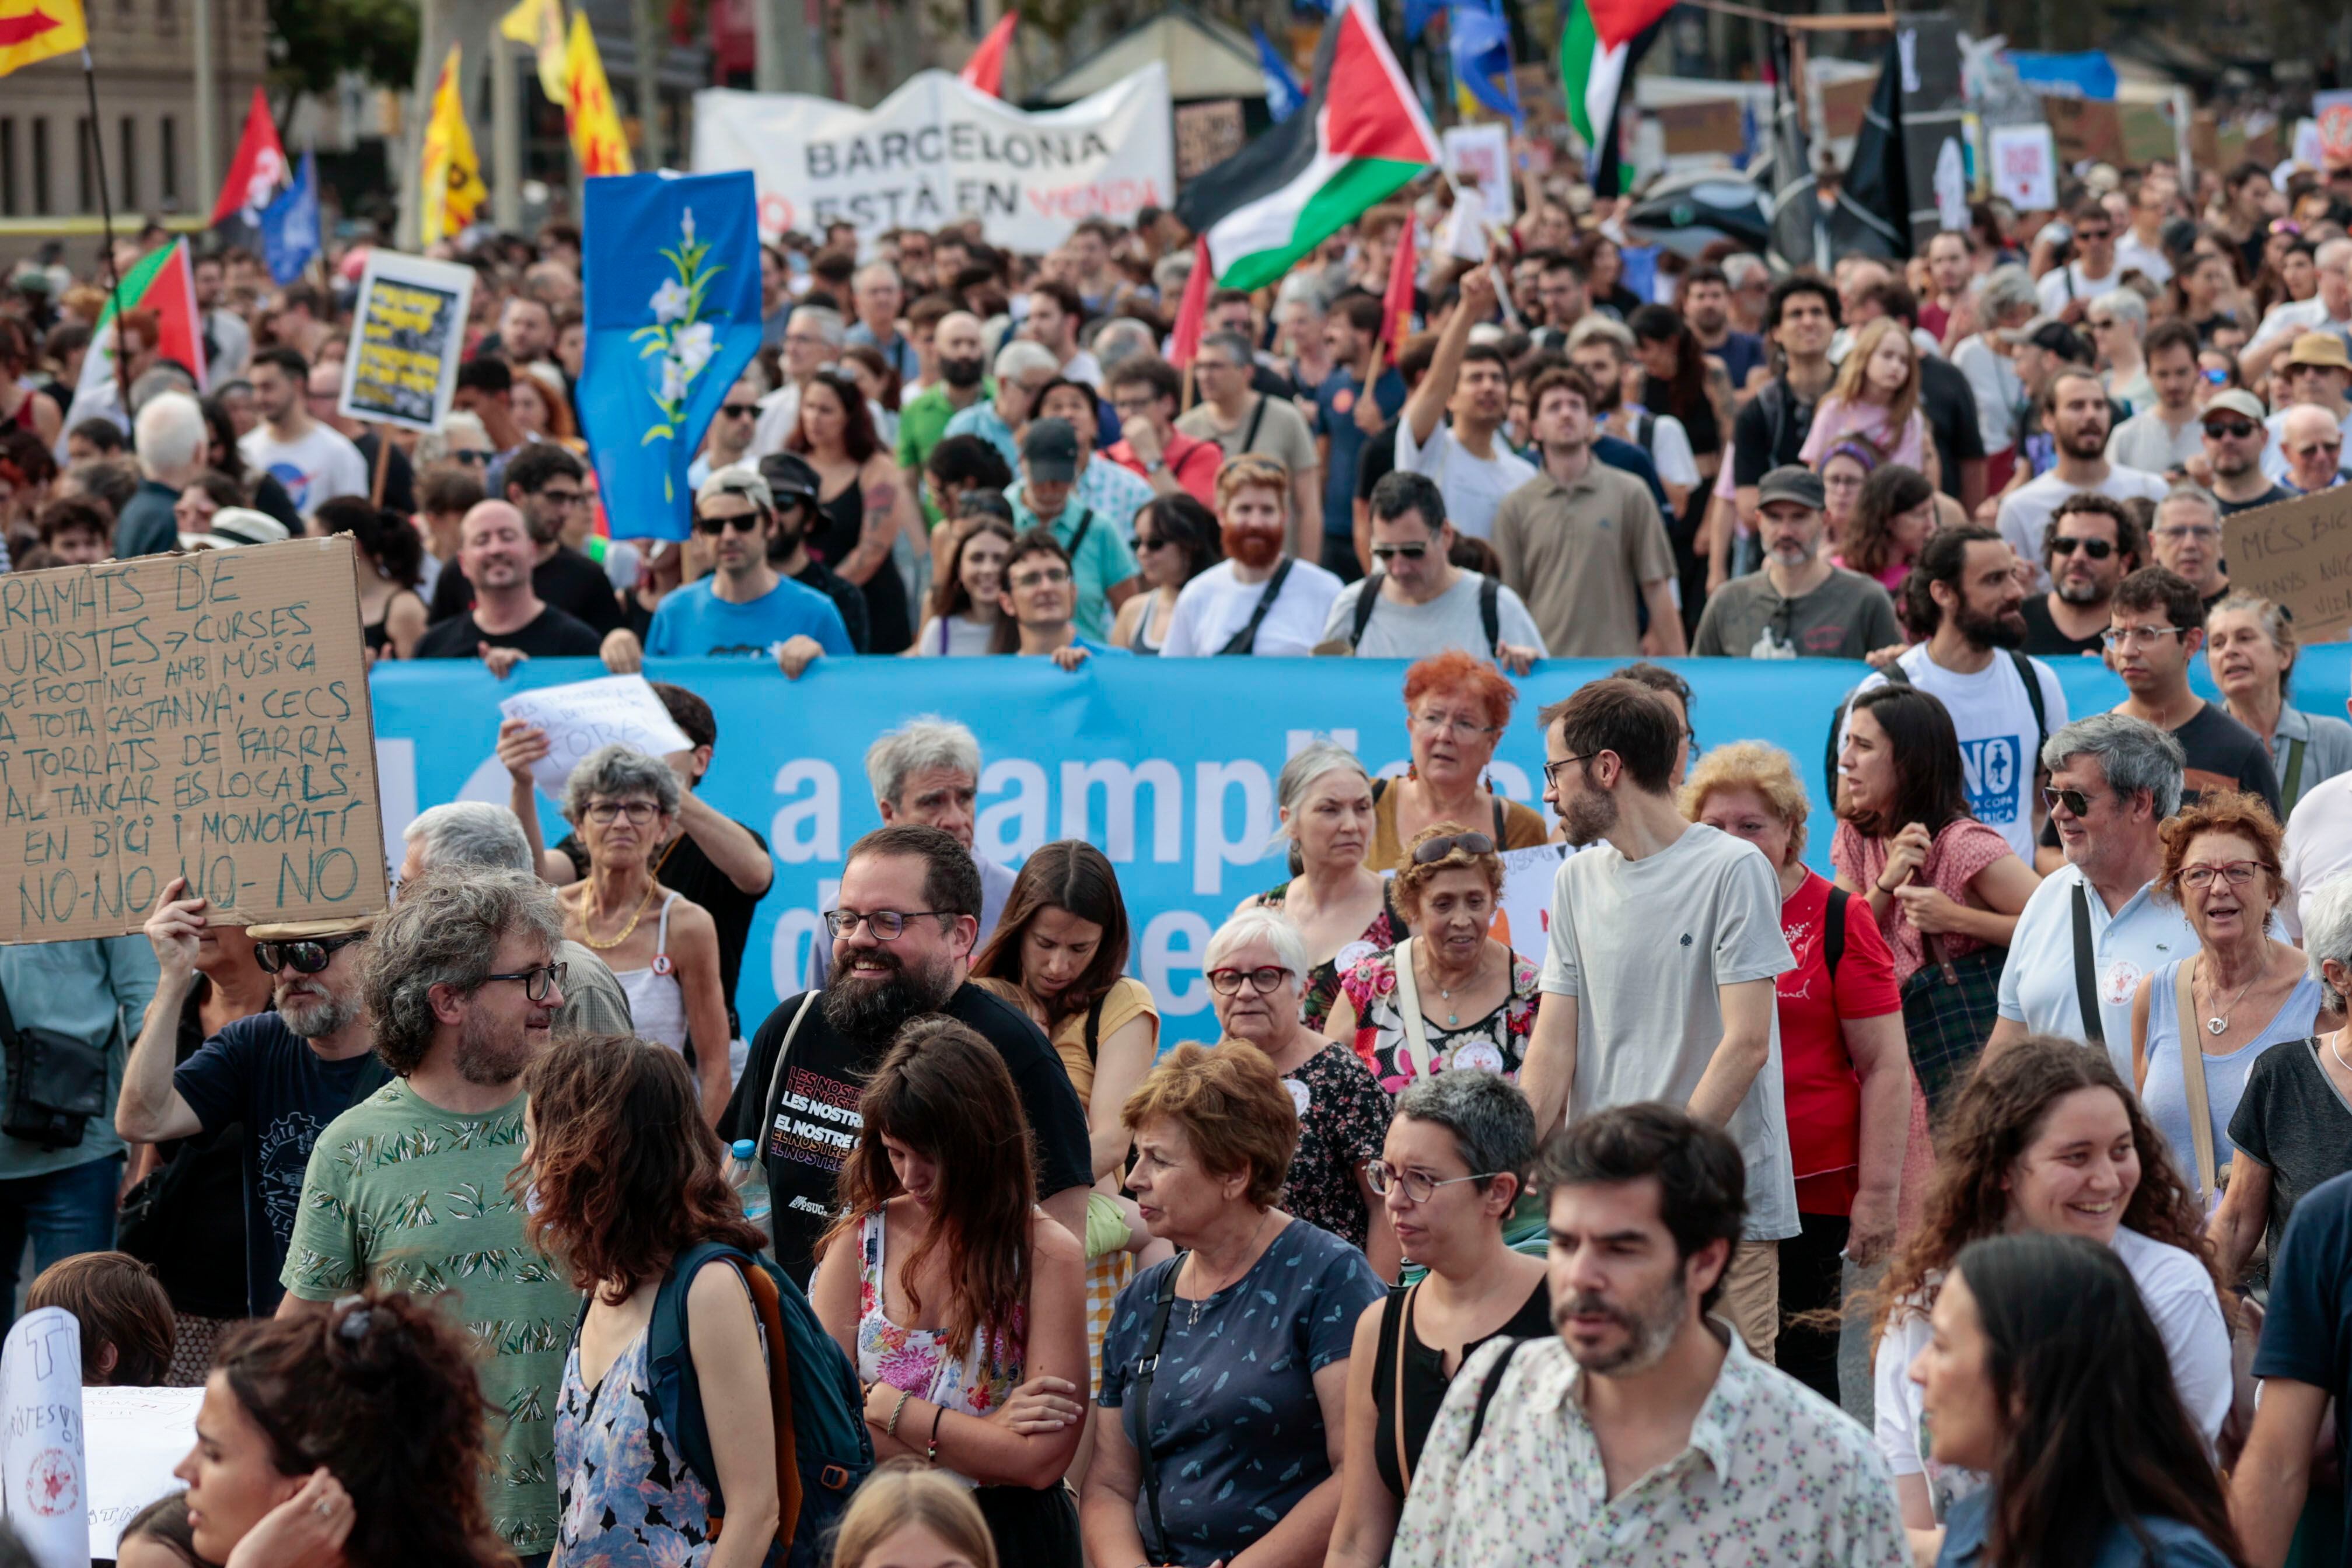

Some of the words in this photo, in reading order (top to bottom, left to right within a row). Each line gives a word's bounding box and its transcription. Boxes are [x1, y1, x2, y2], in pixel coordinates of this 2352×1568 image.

[805, 123, 1110, 178] BARCELONA
[812, 178, 942, 232] ESTÀ
[955, 181, 1020, 217] EN
[1027, 180, 1164, 218] VENDA
[2309, 506, 2352, 542] BIC
[173, 556, 244, 611] DE
[193, 601, 312, 642] CURSES
[165, 656, 206, 688] AMB
[29, 706, 95, 740] TOTA
[262, 681, 351, 723] CECS
[23, 737, 160, 780] TORRATS
[179, 732, 222, 766] DE
[236, 725, 348, 764] FARRA
[5, 785, 50, 827] AL
[51, 775, 160, 817] TANCAR
[771, 758, 840, 863] a
[1984, 796, 2013, 809] COPA
[24, 825, 69, 866] EN
[781, 1090, 810, 1111] LES
[774, 1113, 791, 1132] EL
[791, 1119, 854, 1148] NOSTRE
